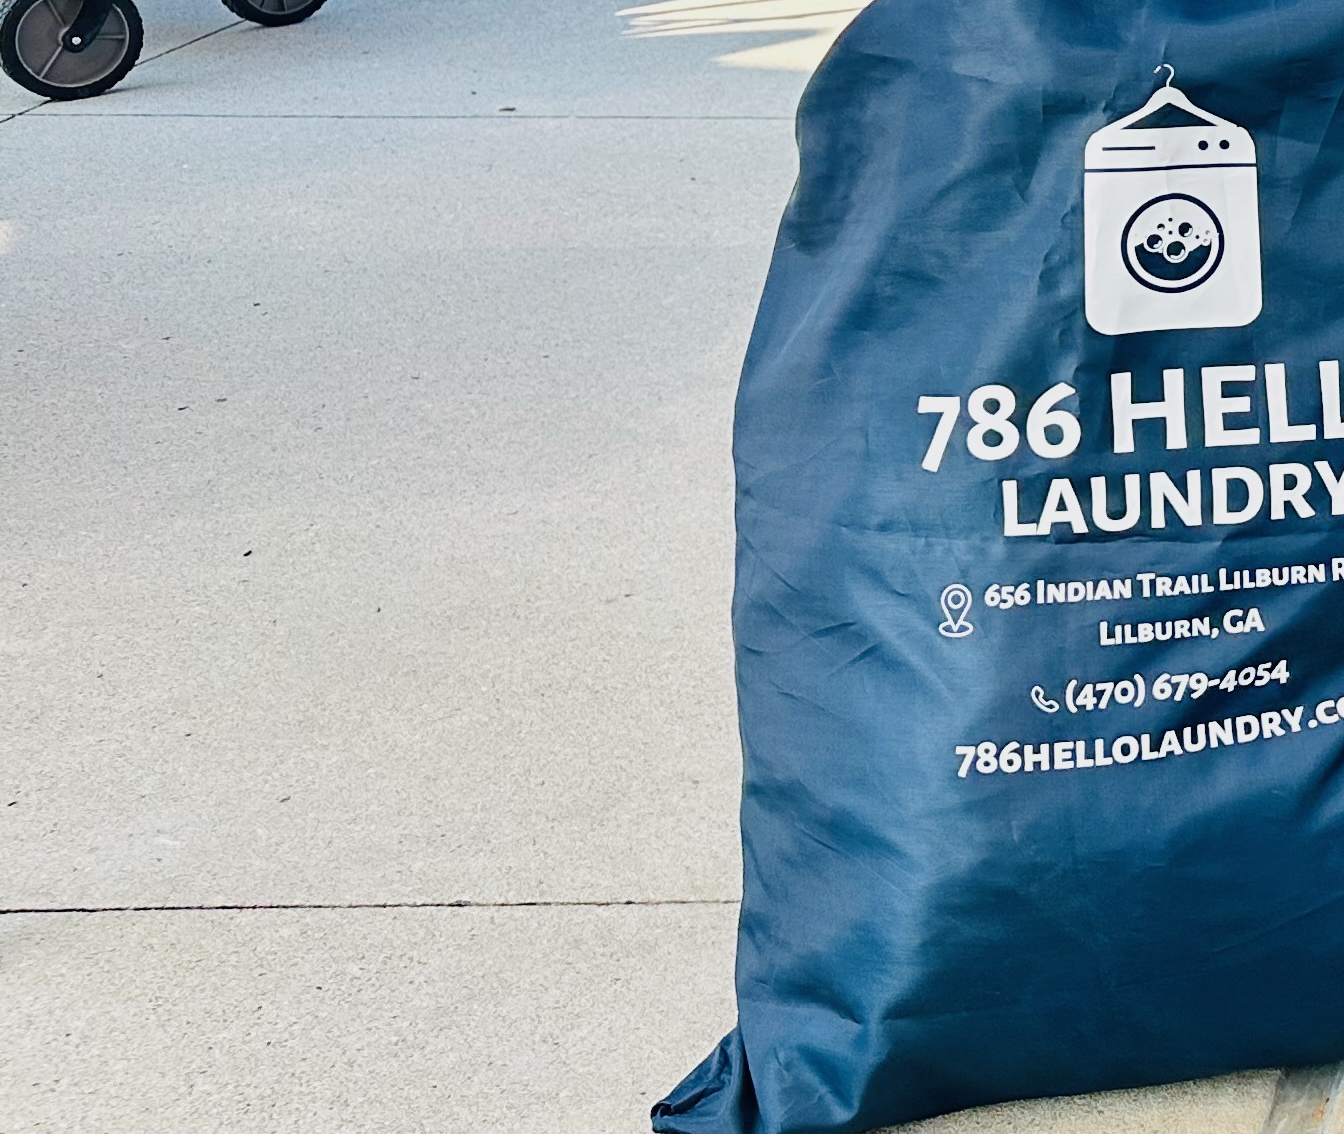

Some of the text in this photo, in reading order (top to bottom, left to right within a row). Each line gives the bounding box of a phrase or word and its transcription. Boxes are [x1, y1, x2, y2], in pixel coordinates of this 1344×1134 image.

[916, 381, 1082, 473] 786
[984, 581, 1031, 610] 656
[1036, 578, 1132, 605] INDIAN
[1136, 572, 1215, 598] TRAIL
[1218, 564, 1326, 591] LILBURN
[1099, 608, 1265, 646] LILBURN, GA
[1064, 660, 1291, 713] (470) 679-4054
